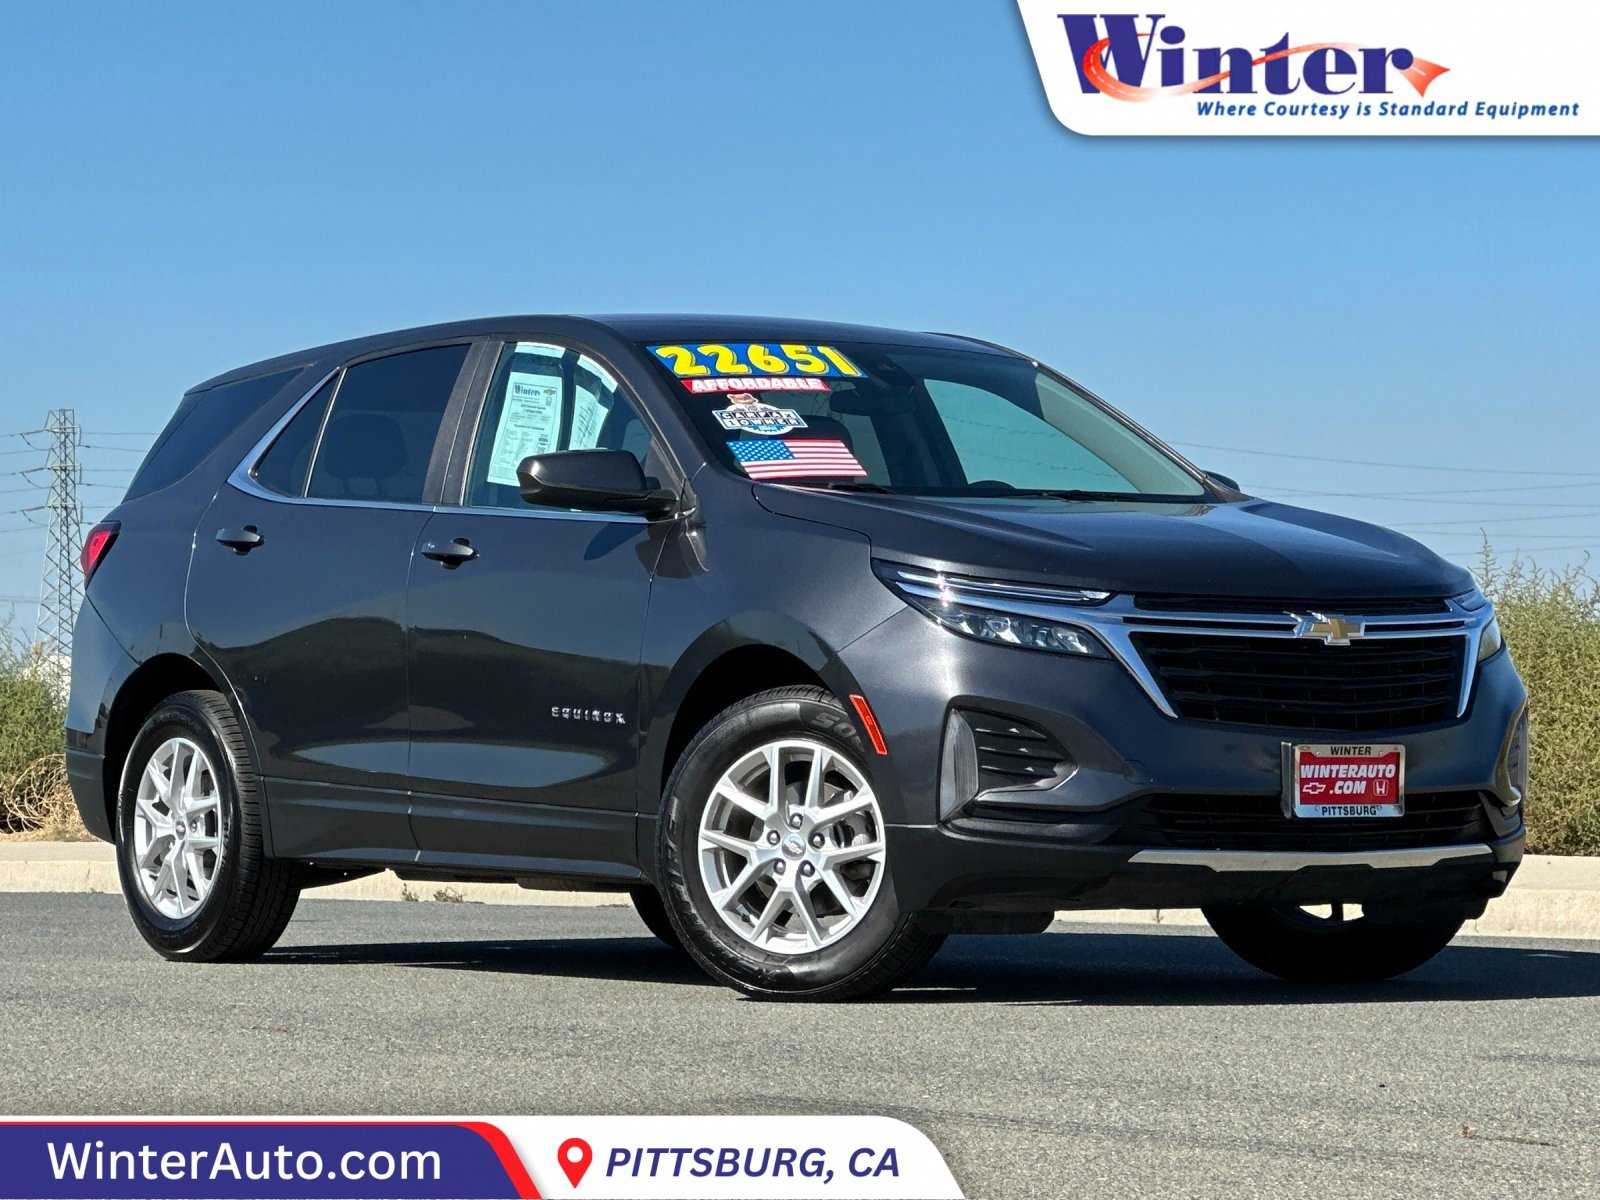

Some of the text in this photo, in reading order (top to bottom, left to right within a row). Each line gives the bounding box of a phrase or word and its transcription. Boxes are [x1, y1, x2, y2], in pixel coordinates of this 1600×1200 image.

[655, 343, 862, 376] 22651
[691, 377, 827, 392] AFFORDABLE
[551, 706, 626, 724] EQUINOX
[1330, 746, 1372, 756] WINTER
[1300, 764, 1396, 779] WINTERAUTO
[1329, 780, 1367, 795] .COM
[1321, 805, 1377, 816] PITTSBURG
